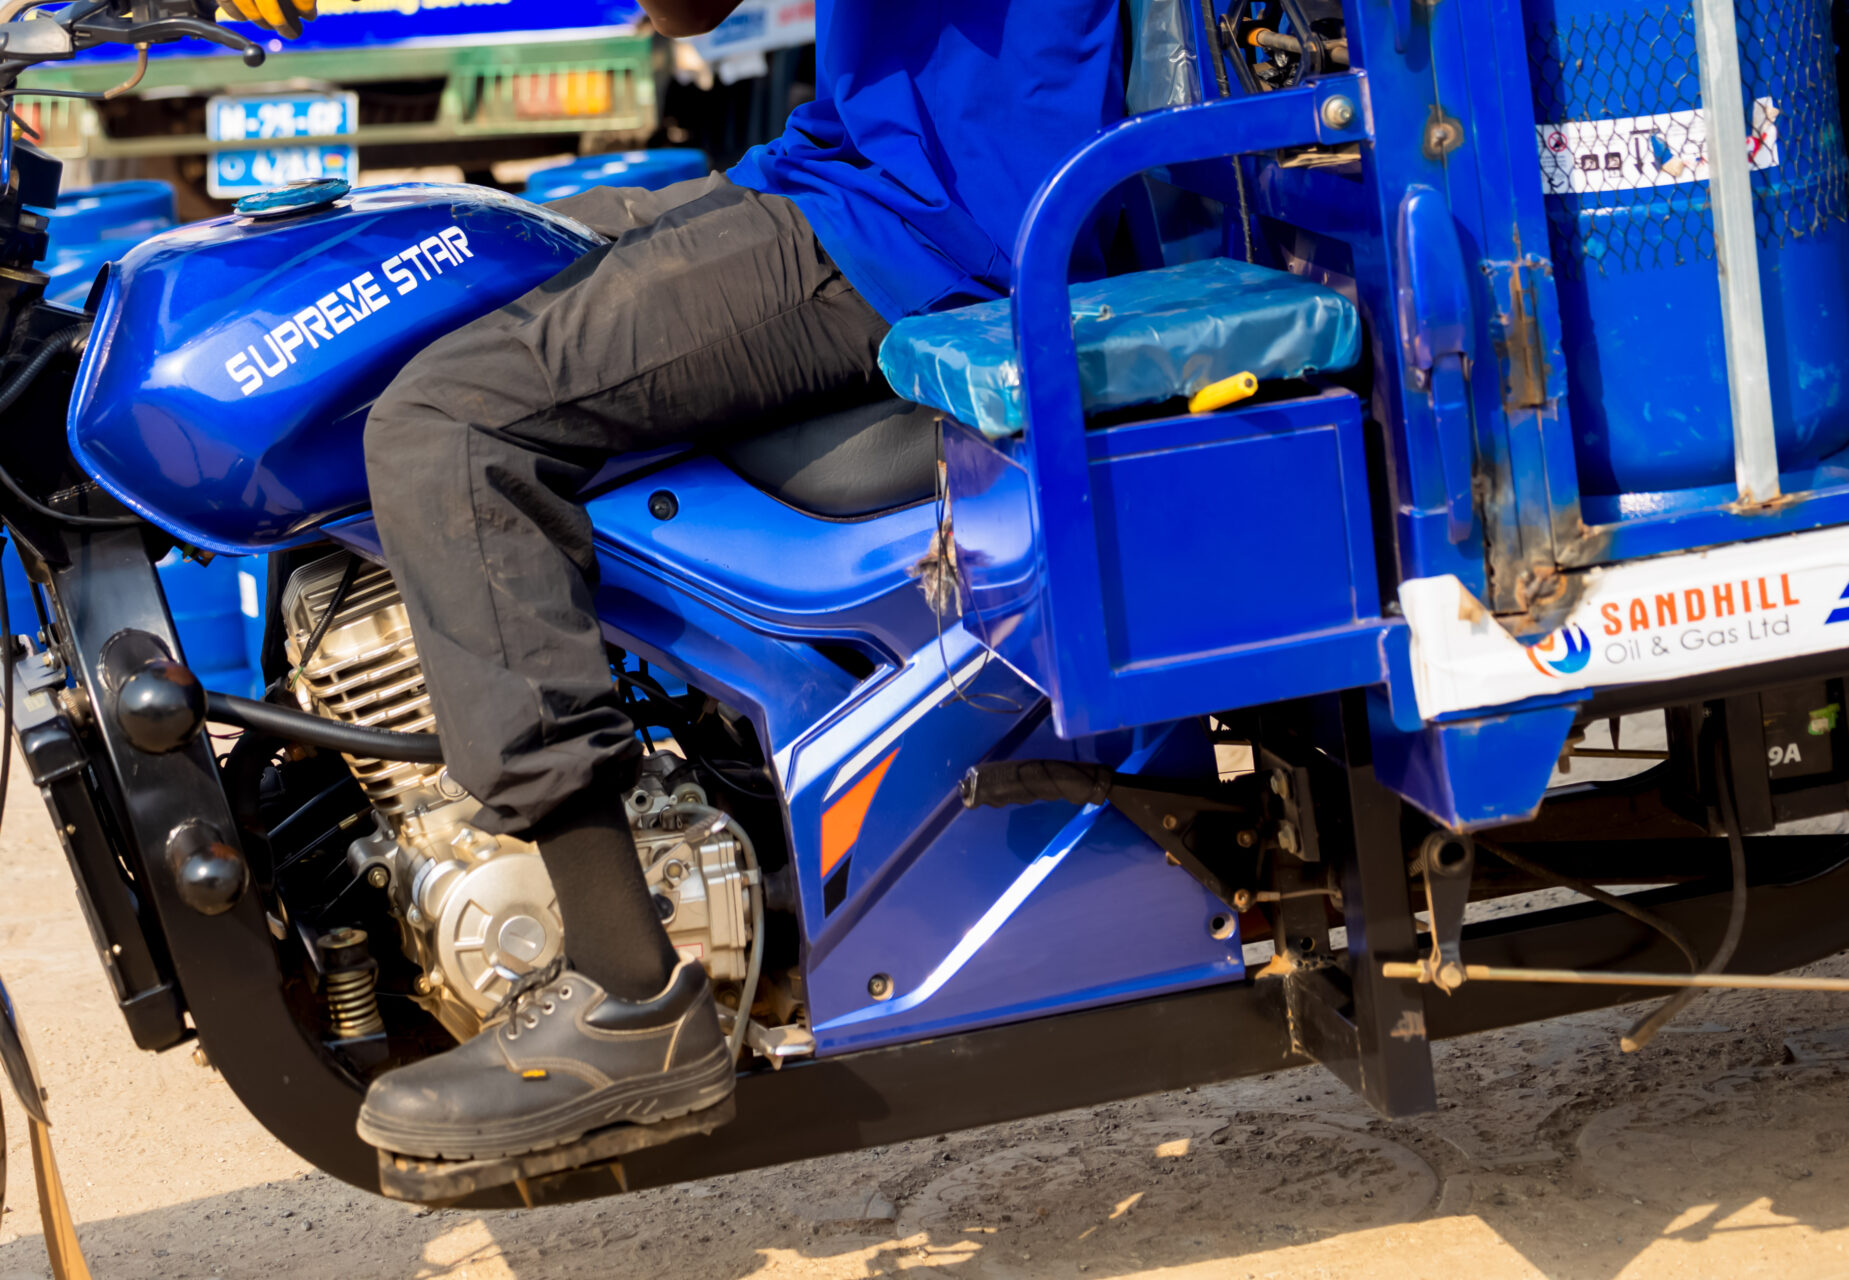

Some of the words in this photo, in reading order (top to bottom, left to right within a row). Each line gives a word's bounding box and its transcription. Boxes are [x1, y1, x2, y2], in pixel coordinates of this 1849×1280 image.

[225, 271, 391, 396] SUPREME
[381, 225, 474, 296] STAR
[1600, 573, 1800, 636] SANDHILL
[1605, 639, 1641, 664] Oil
[1651, 635, 1670, 657] &
[1680, 627, 1739, 651] Gas
[1749, 614, 1791, 641] Ltd
